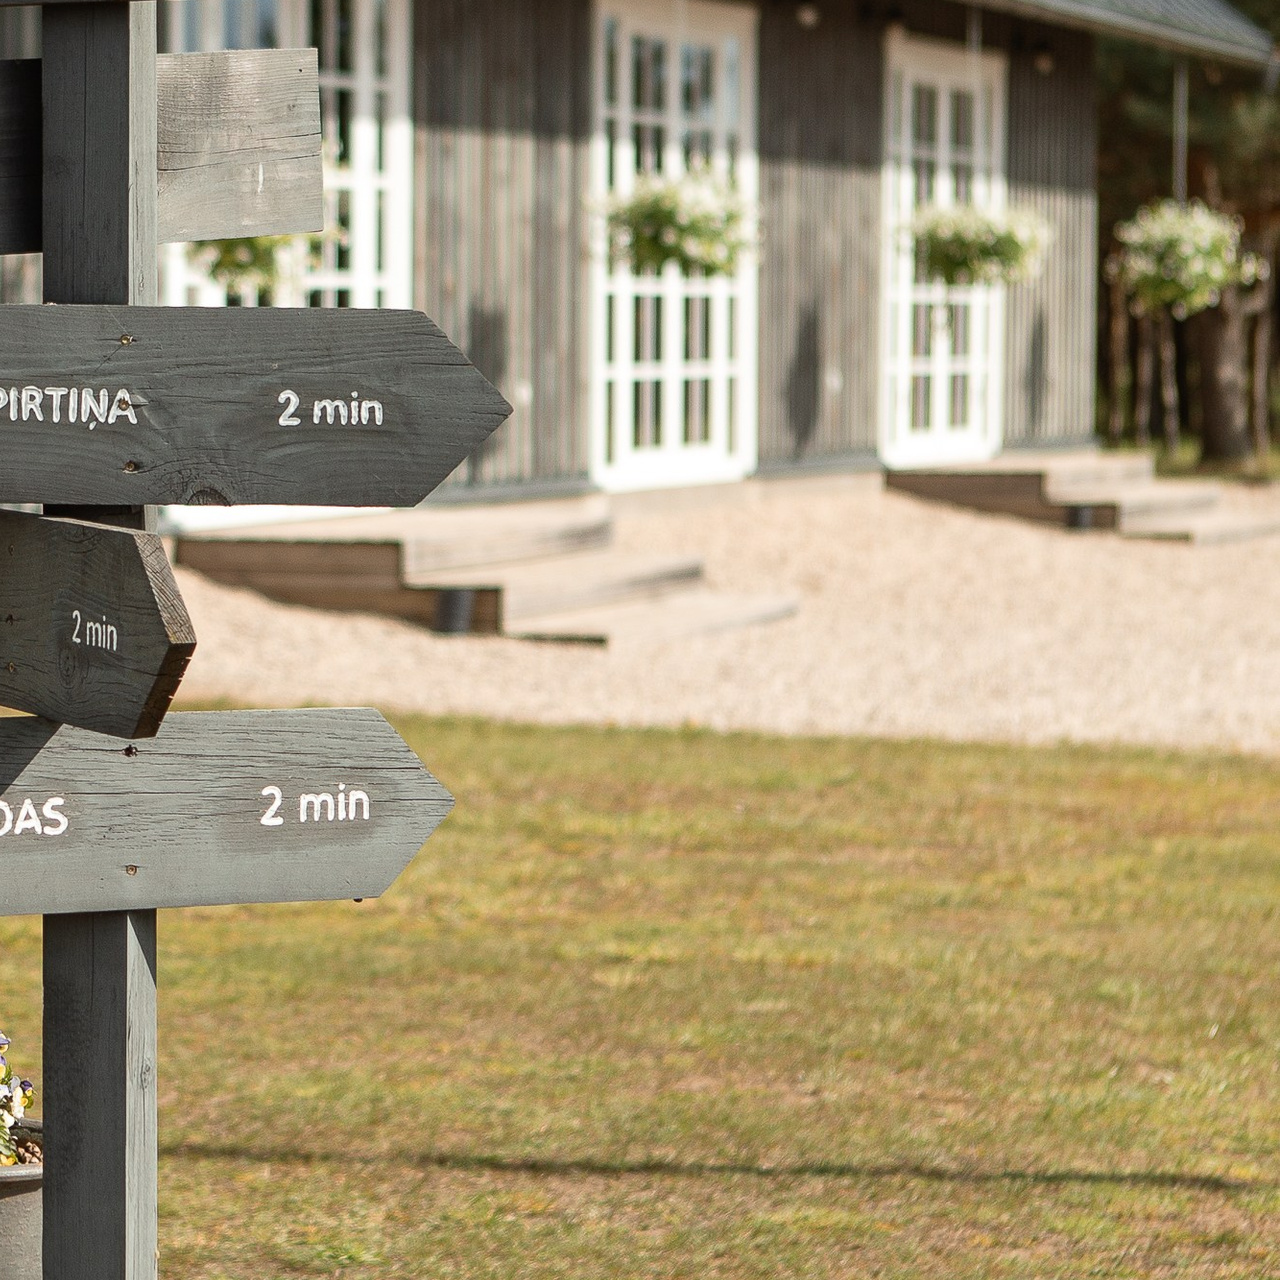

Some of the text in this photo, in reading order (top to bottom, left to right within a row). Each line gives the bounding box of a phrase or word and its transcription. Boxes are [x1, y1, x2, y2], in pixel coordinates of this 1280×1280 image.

[277, 389, 302, 427] 2
[312, 390, 384, 426] min
[72, 609, 82, 644] 2
[86, 615, 118, 652] min
[259, 785, 285, 826] 2
[298, 781, 371, 823] min
